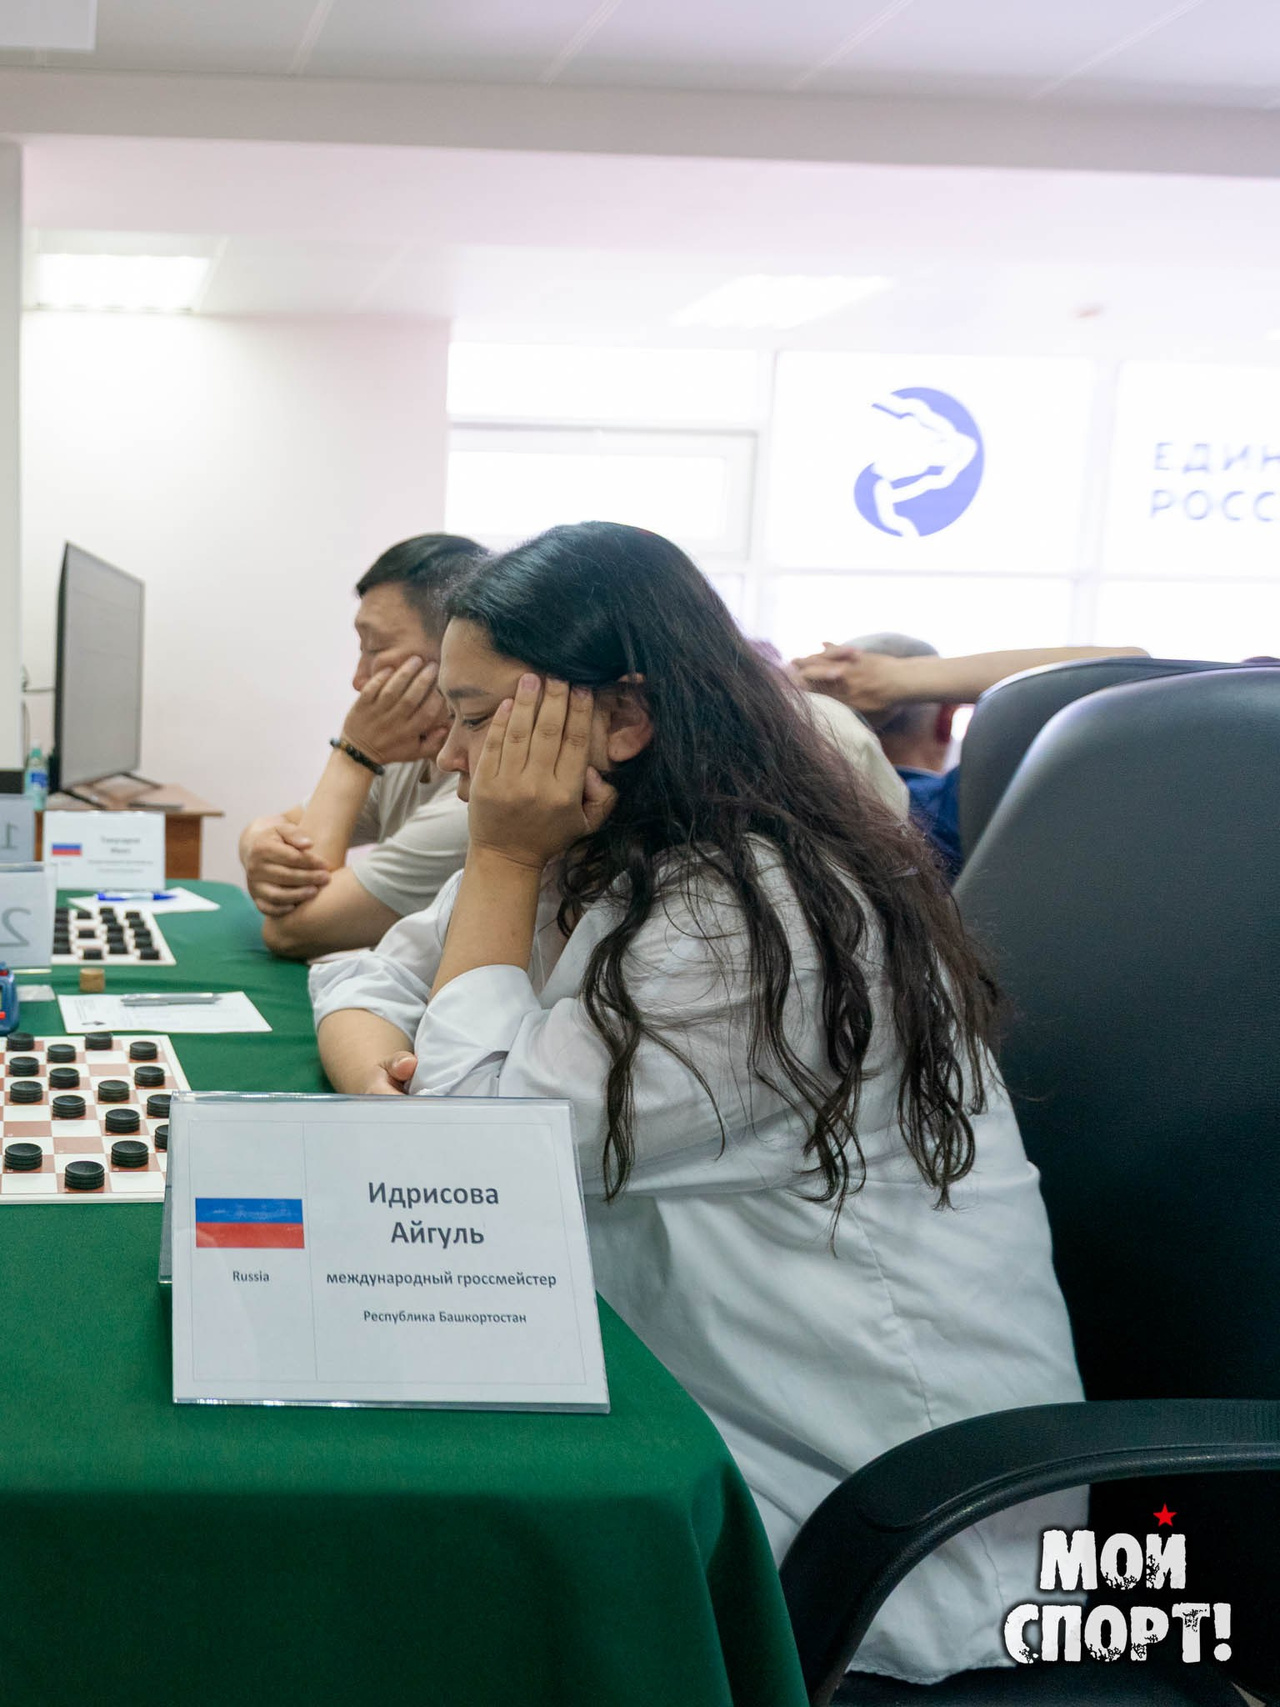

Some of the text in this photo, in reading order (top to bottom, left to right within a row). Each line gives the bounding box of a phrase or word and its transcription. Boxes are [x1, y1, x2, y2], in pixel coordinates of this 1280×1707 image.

[1149, 488, 1276, 522] РОСС
[368, 1181, 500, 1210] Идрисова
[390, 1219, 485, 1251] Айгуль
[232, 1269, 270, 1283] Russia
[326, 1270, 558, 1289] международный гроссмейстер
[363, 1309, 527, 1325] Республика Башкортостан
